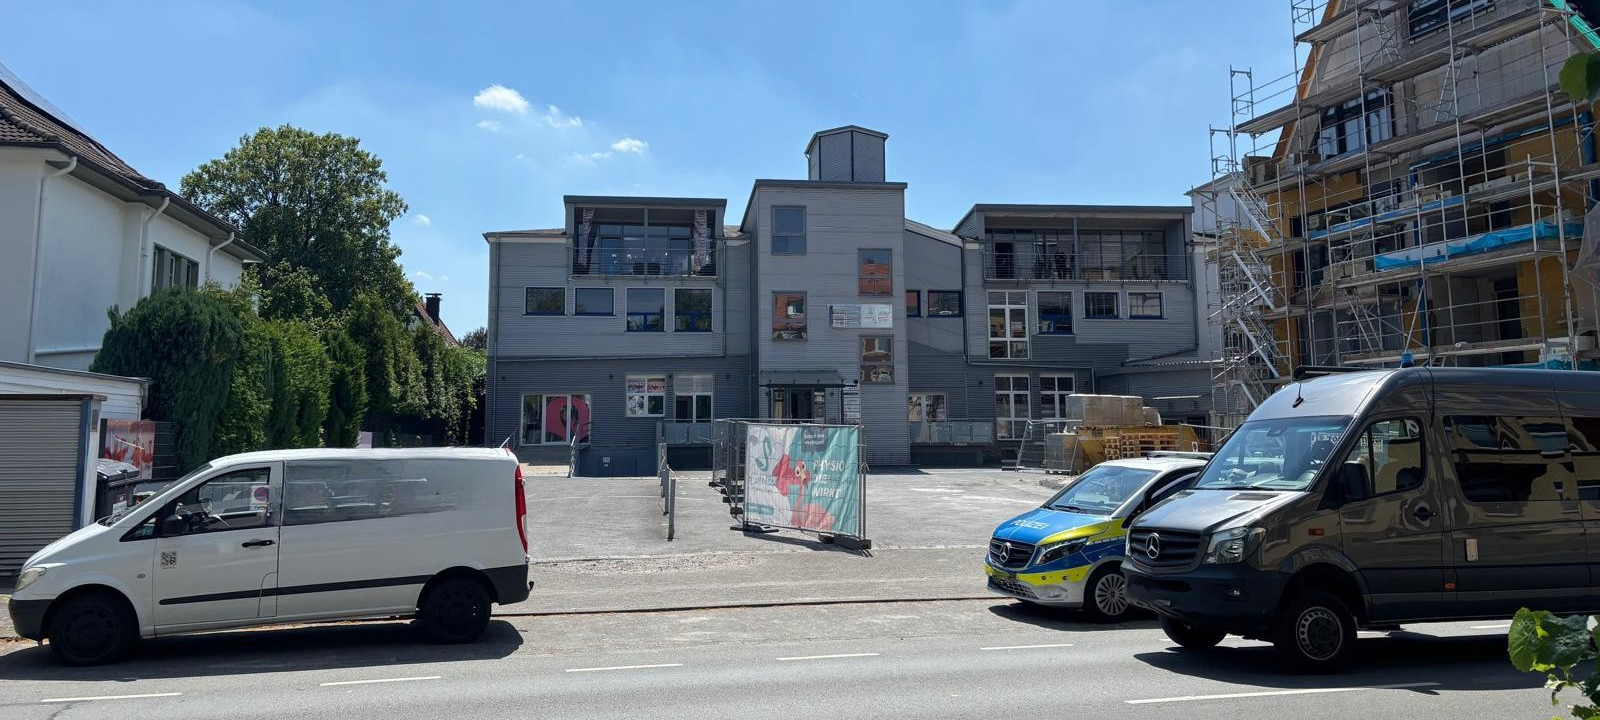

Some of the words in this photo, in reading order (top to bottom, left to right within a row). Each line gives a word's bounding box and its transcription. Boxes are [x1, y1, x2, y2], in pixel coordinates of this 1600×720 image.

[813, 459, 845, 472] PHYSIO
[811, 487, 842, 499] WIRKT
[1010, 519, 1051, 530] POLIZEI
